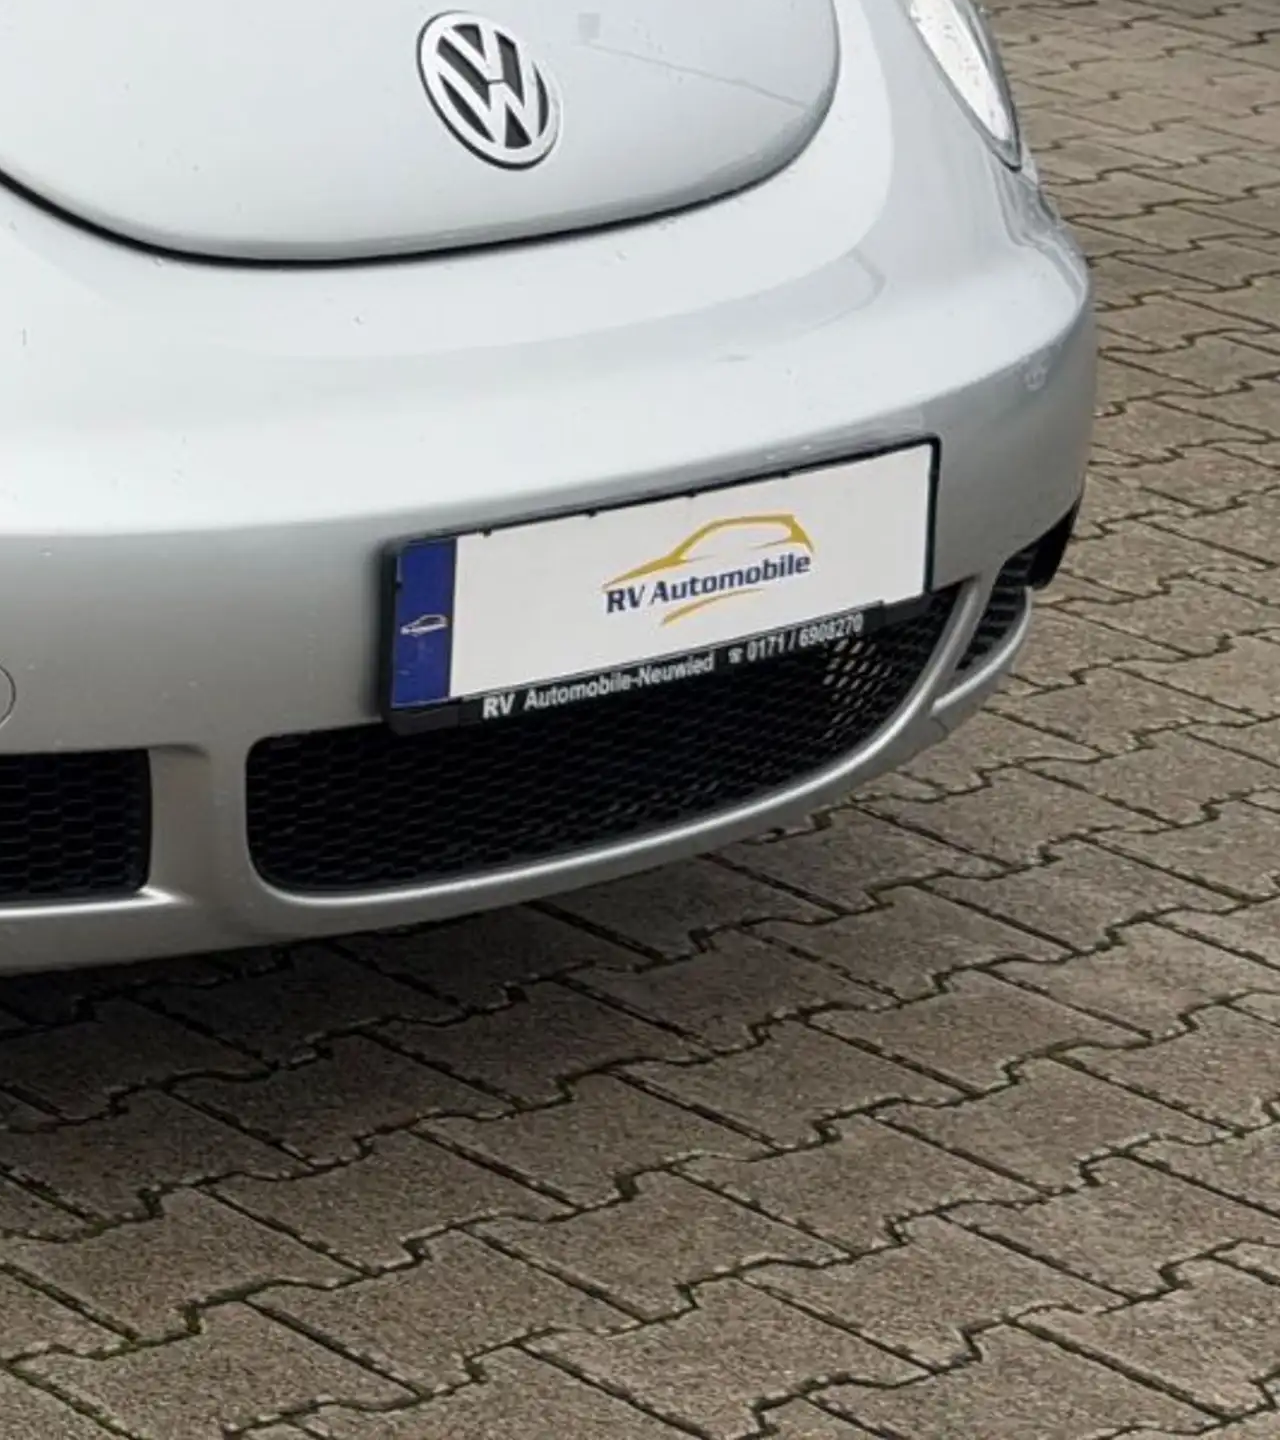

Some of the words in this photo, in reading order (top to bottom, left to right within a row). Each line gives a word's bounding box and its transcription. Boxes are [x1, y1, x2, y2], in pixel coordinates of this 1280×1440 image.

[605, 584, 646, 614] RV
[650, 552, 812, 606] Automobile
[482, 692, 517, 720] RV
[523, 652, 716, 711] Automobile-Neuwied
